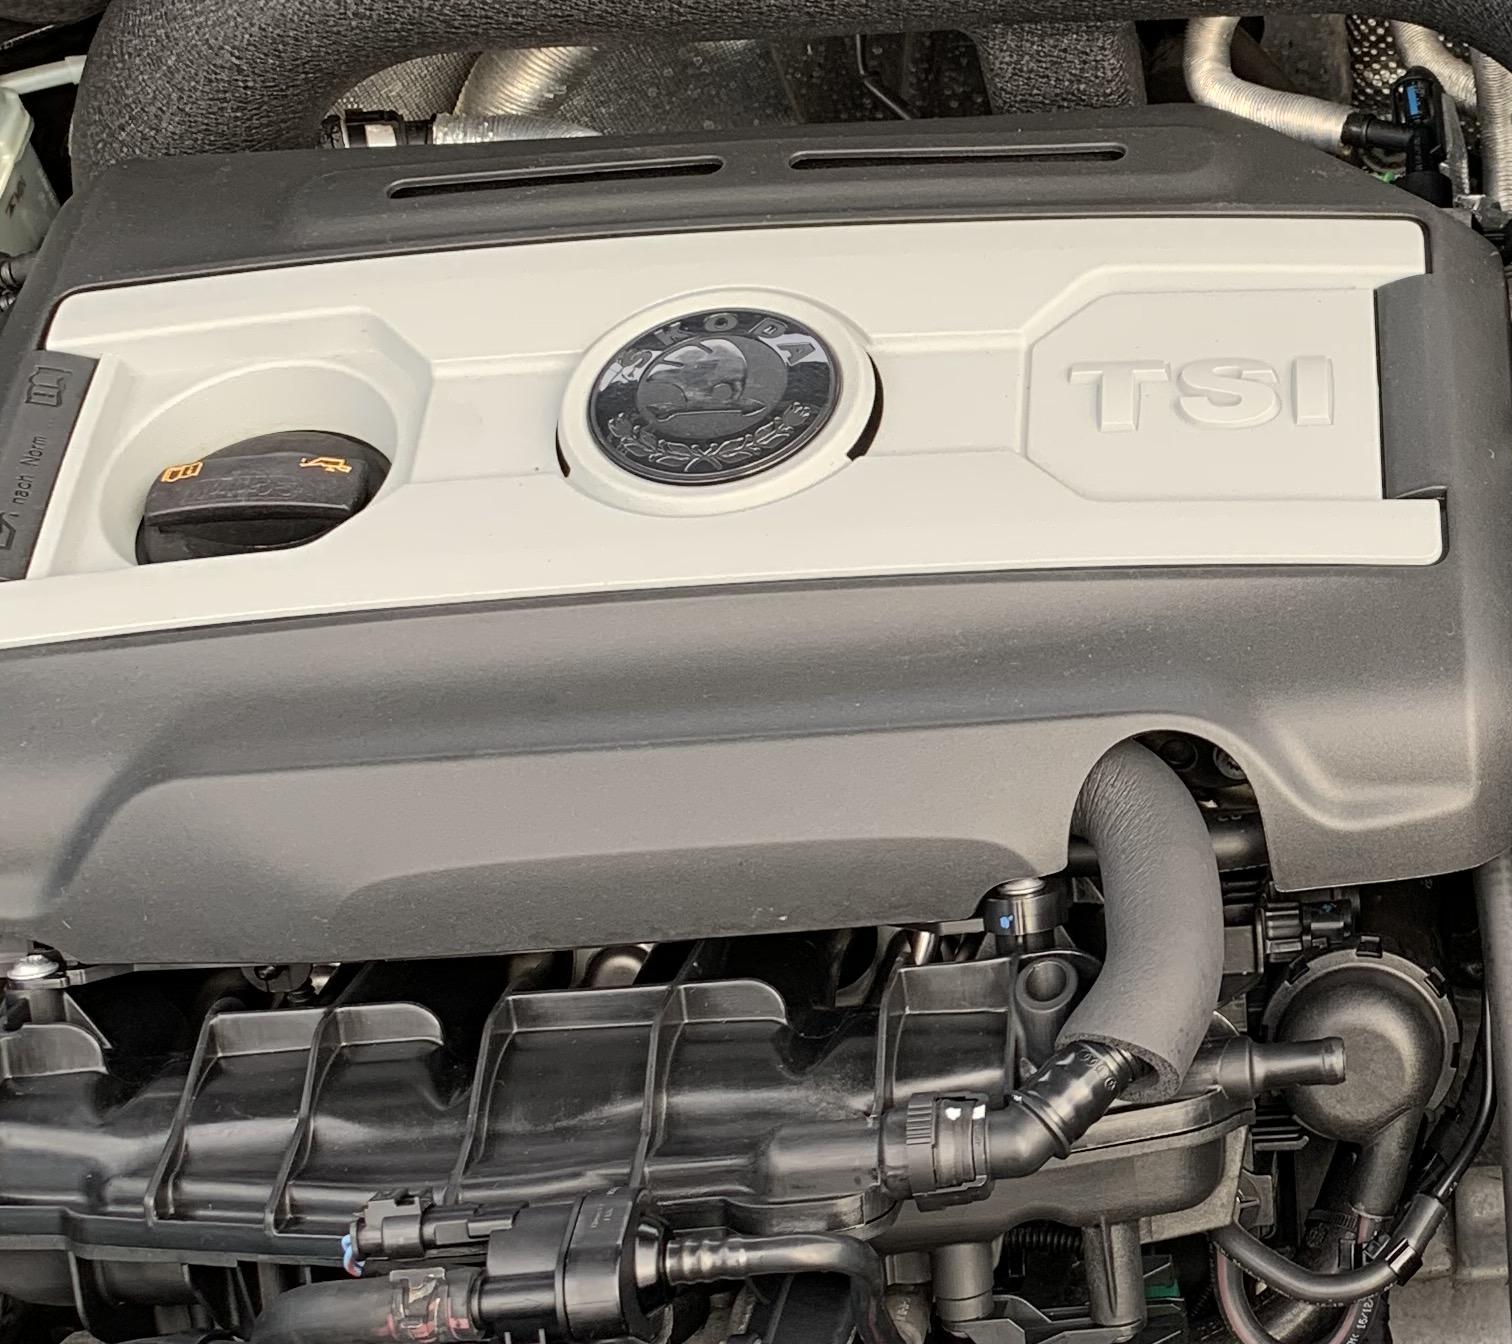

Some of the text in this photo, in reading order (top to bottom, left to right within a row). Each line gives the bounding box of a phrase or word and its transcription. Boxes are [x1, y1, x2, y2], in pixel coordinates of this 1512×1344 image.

[1067, 355, 1334, 432] TSI
[12, 435, 47, 505] nach Norm
